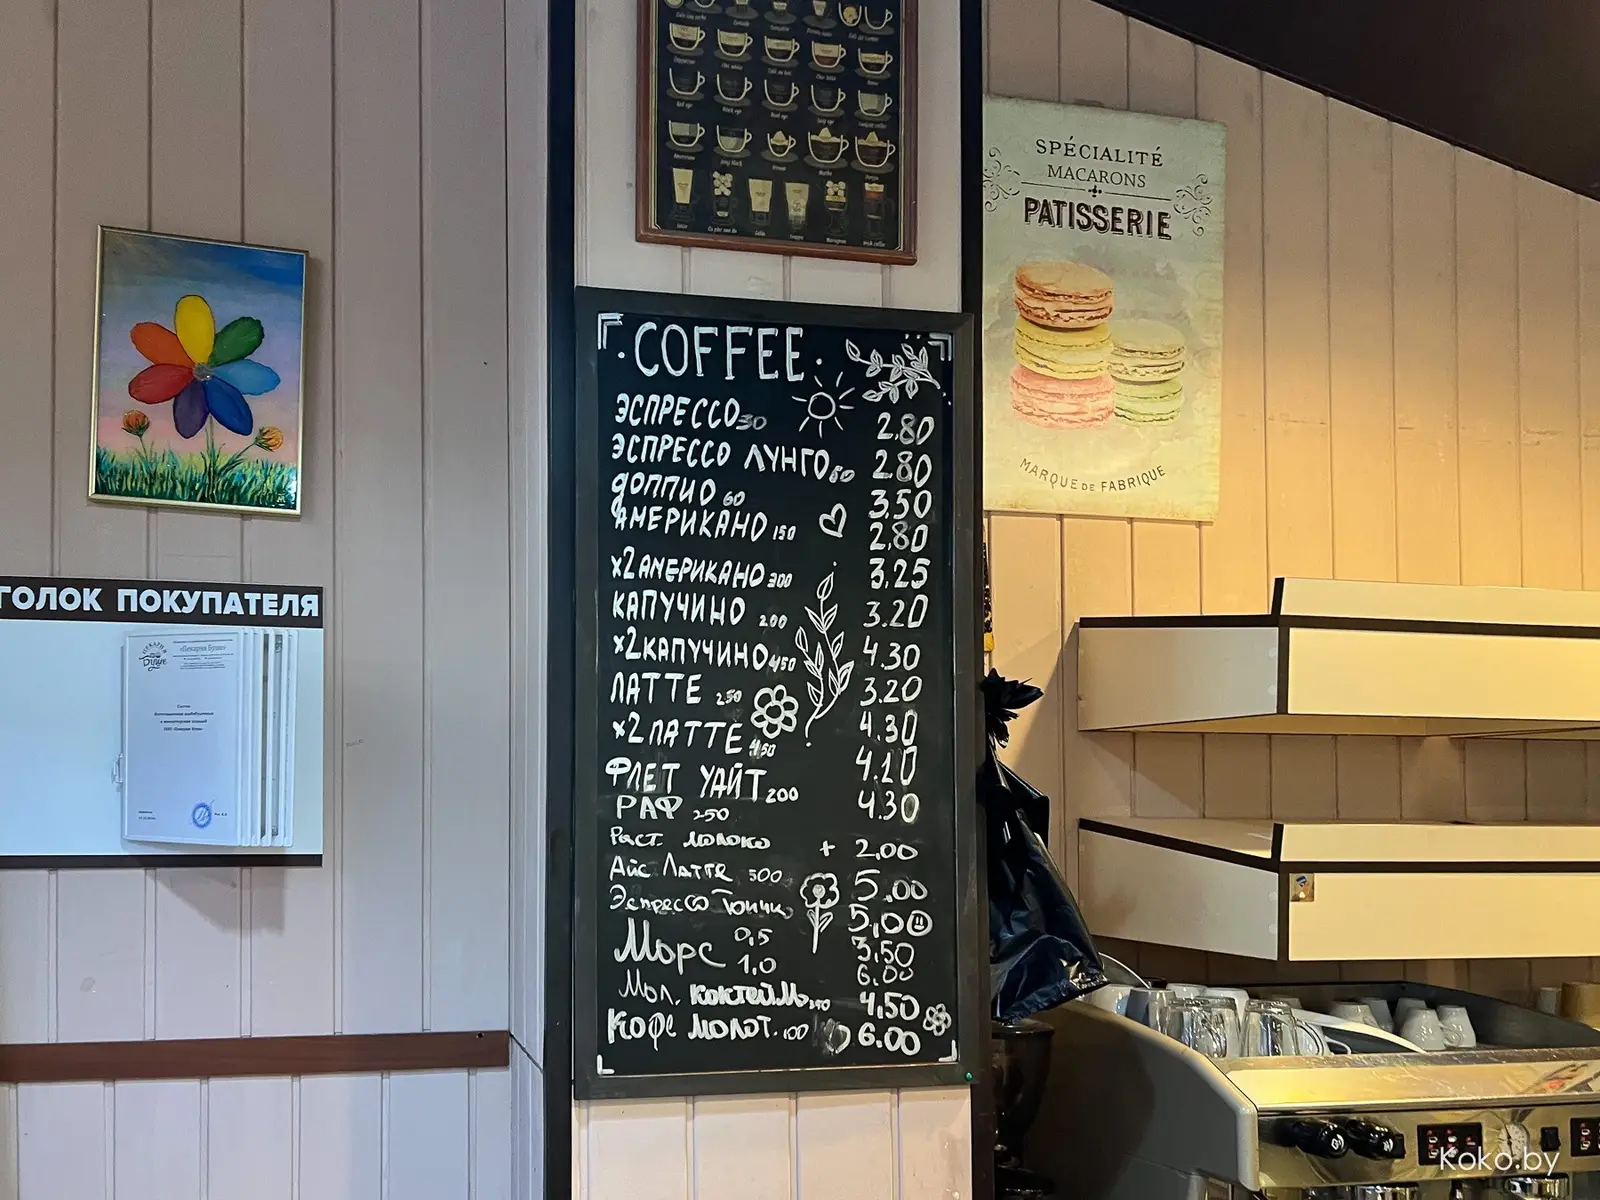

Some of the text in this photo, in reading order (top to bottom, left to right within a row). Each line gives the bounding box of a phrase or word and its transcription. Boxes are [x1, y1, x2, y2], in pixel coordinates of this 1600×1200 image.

[1035, 136, 1163, 167] SPÉCIALITÉ
[1047, 165, 1146, 188] MACARONS
[1024, 197, 1172, 240] PATISSERIE
[635, 321, 804, 382] COFFEE
[615, 392, 741, 431] ЭСПРЕССО
[736, 413, 768, 431] 30
[612, 433, 731, 468] ЭСПРЕССО
[744, 444, 830, 481] ЛУНГО
[1019, 457, 1078, 490] MARQUE
[1101, 464, 1166, 492] FABRIQUE
[723, 491, 745, 508] 60
[772, 525, 796, 541] 150
[767, 573, 792, 589] 300
[117, 588, 319, 617] ПОКУПАТЕЛЯ
[613, 590, 746, 626] КАПУЧИНО
[759, 614, 787, 629] 200
[610, 672, 702, 705] ЛАТТЕ
[716, 689, 743, 705] 250
[605, 757, 680, 793] ФЛЕТ
[700, 762, 767, 802] УАЙТ
[765, 787, 799, 804] 200
[616, 794, 683, 820] РАФ
[692, 807, 729, 823] 250
[608, 856, 651, 881] Айс
[749, 867, 782, 883] 500
[614, 916, 726, 975] Морс
[734, 927, 773, 947] 0,5
[738, 953, 776, 975] 1,0
[608, 1008, 677, 1051] Кофе
